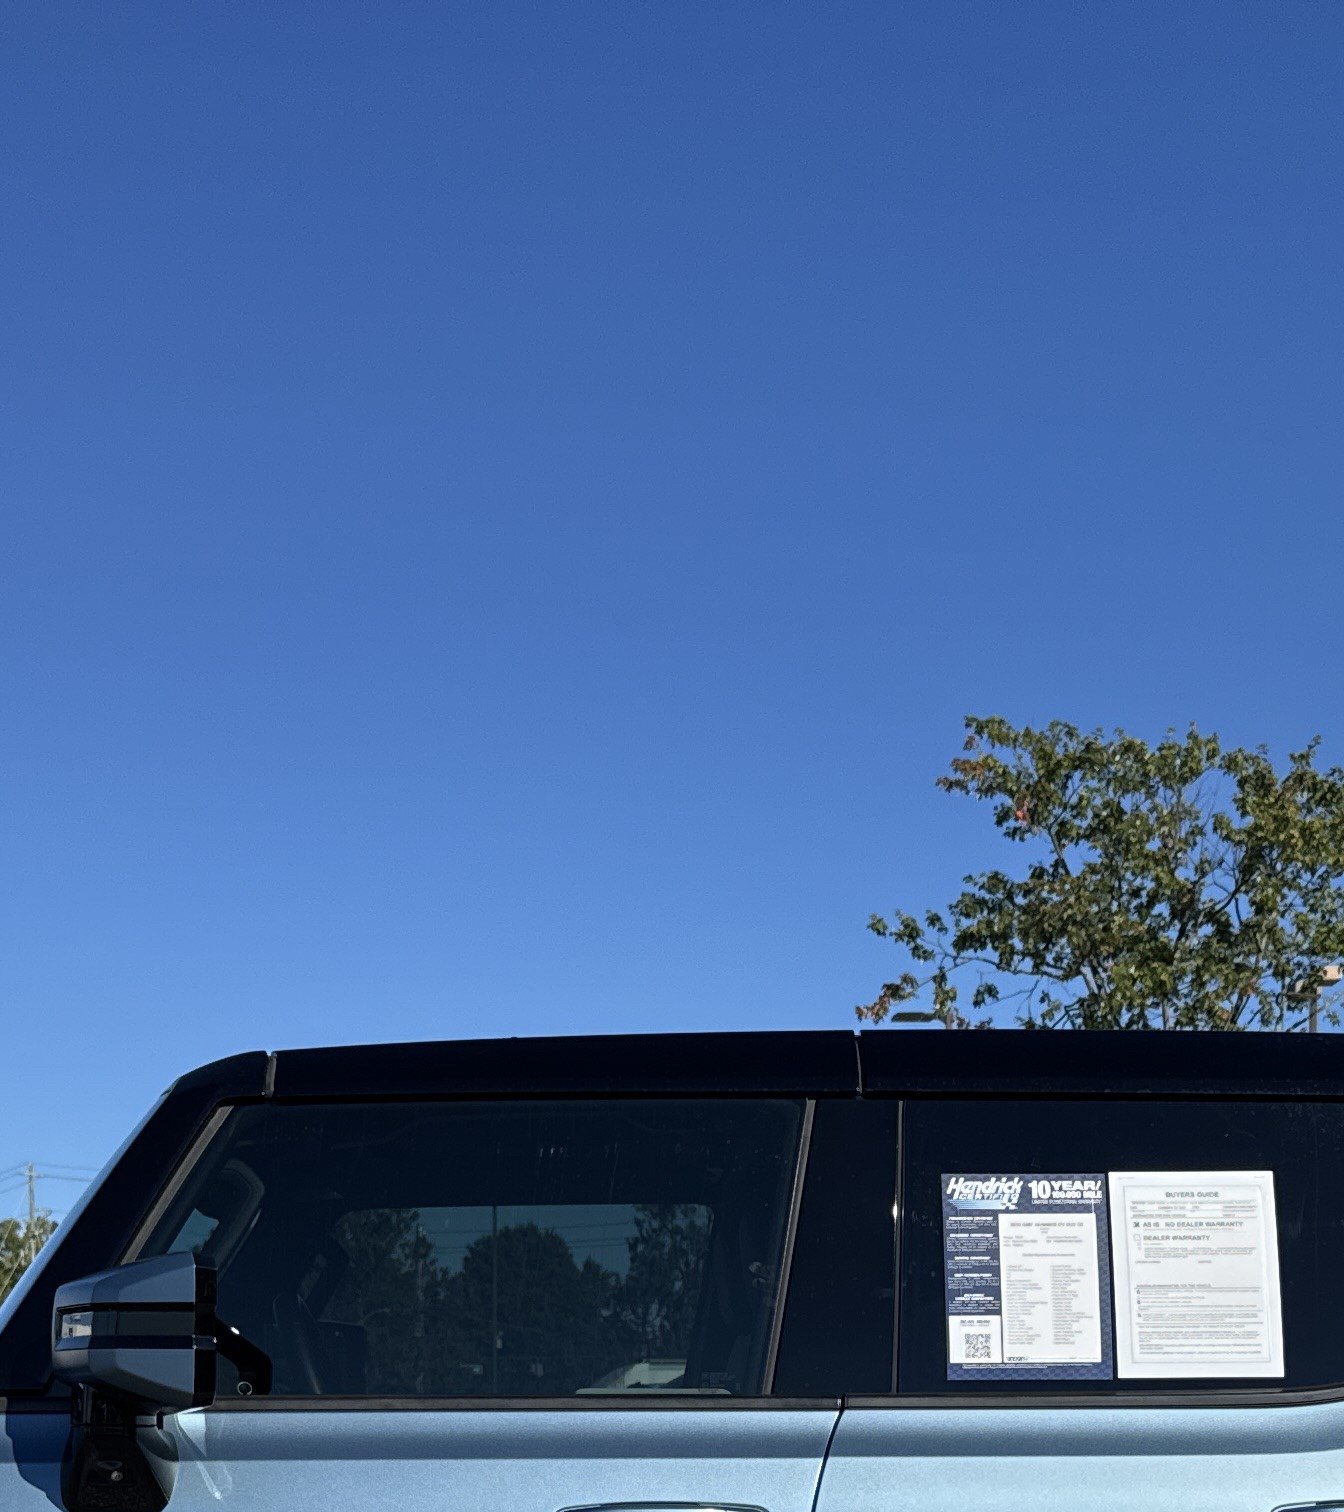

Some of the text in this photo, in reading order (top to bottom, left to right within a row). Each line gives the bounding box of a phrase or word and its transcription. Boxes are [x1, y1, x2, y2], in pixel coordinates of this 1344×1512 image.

[946, 1177, 1023, 1199] Hendrick
[1028, 1180, 1101, 1198] 10 YEAR/
